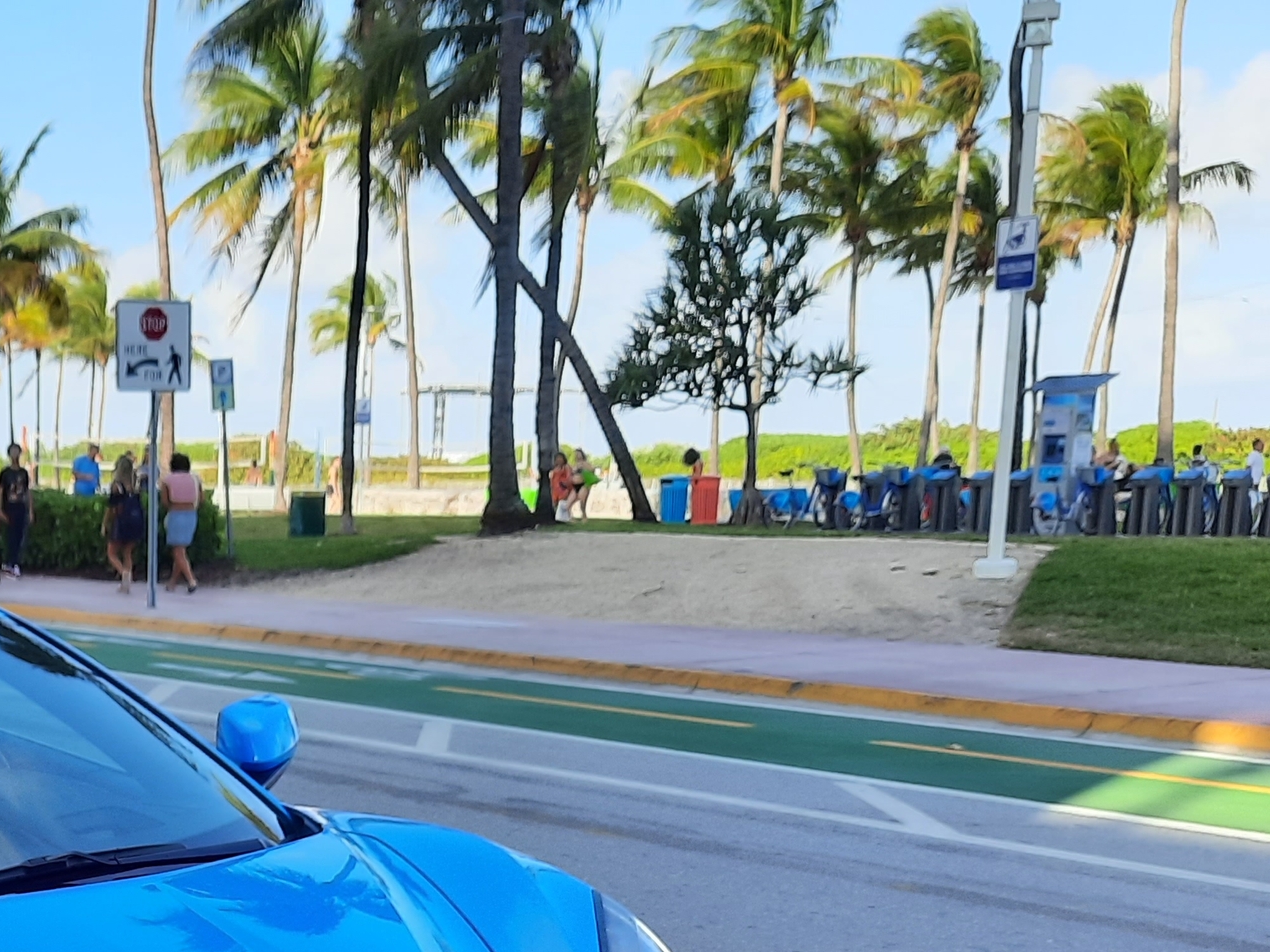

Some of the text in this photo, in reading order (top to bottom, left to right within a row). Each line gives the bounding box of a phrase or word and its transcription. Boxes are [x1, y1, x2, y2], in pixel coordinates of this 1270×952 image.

[141, 317, 166, 332] STOP
[124, 345, 148, 356] HERE
[143, 369, 163, 382] FOR
